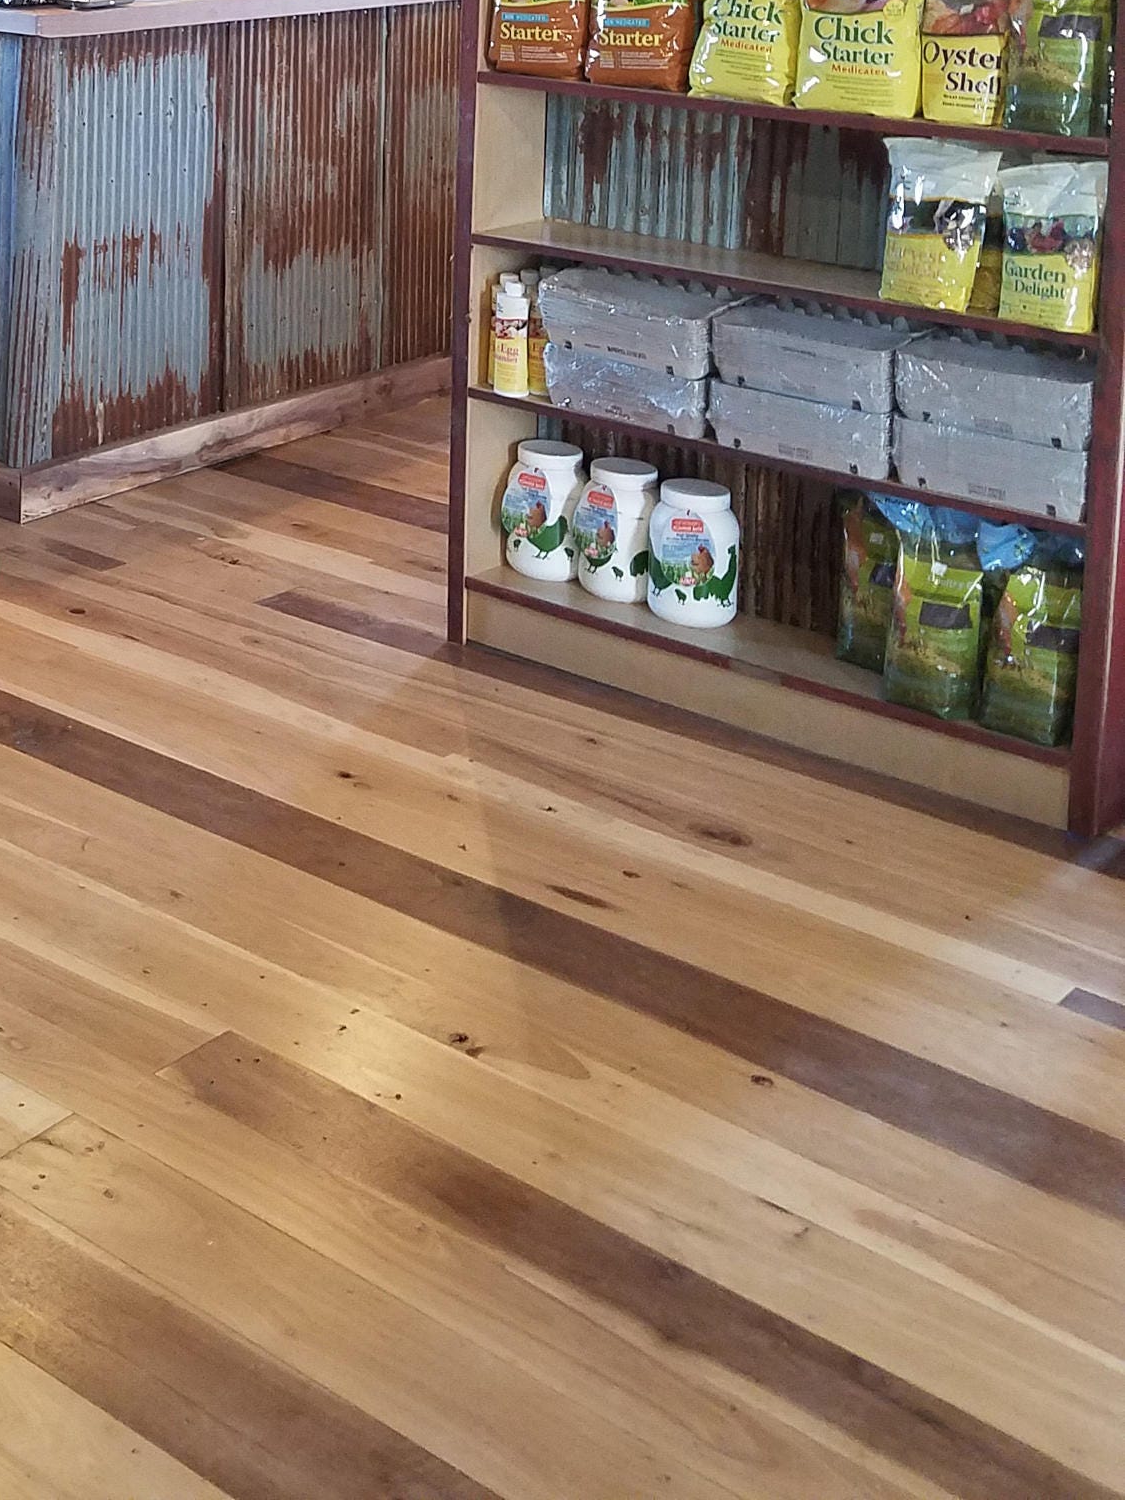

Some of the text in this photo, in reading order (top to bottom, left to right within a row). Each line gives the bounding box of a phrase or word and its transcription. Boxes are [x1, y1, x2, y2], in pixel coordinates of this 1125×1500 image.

[500, 22, 562, 41] Starter
[599, 28, 664, 47] Starter
[814, 16, 894, 45] Chick
[720, 40, 772, 53] Medicated
[821, 41, 894, 66] Starter
[946, 72, 1001, 96] Shell
[1005, 259, 1066, 284] Garden
[1014, 279, 1066, 301] Delight
